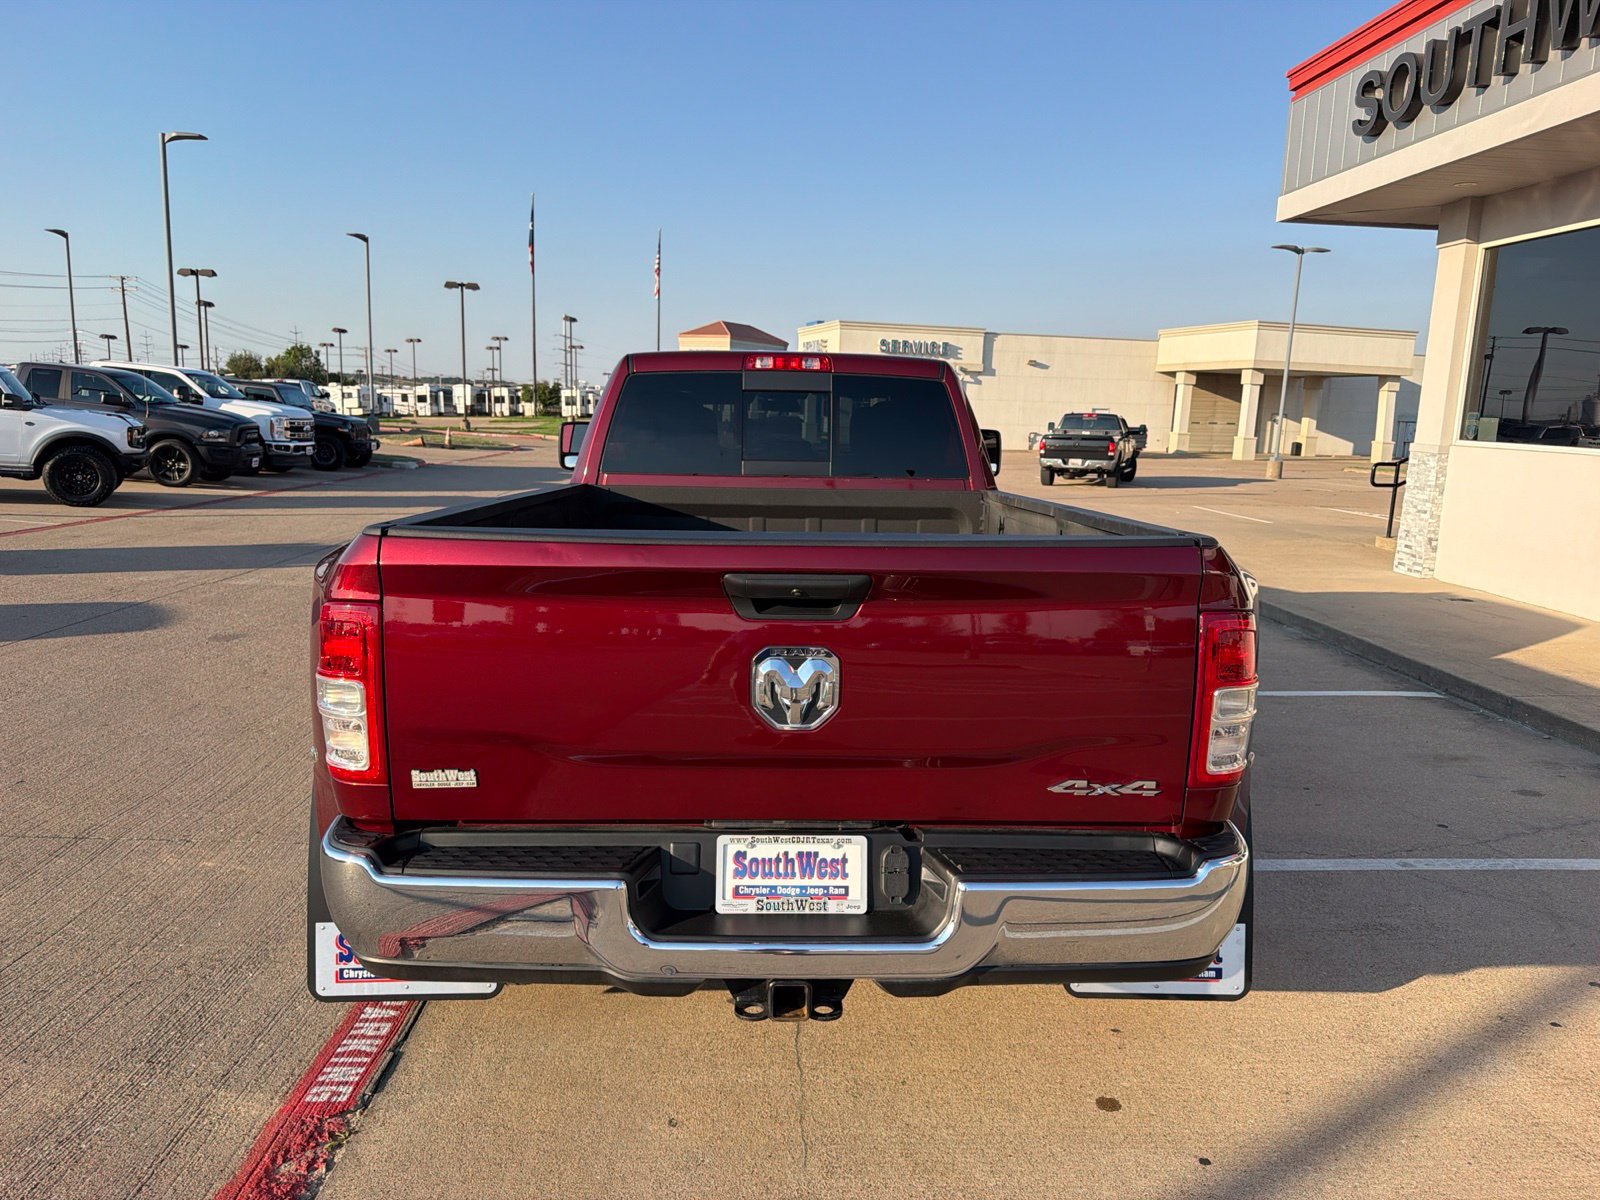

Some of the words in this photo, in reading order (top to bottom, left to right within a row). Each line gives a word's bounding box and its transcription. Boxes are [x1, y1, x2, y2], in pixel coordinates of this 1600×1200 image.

[880, 339, 950, 357] SERVICE
[770, 648, 826, 656] RAM
[411, 769, 476, 781] SouthWest
[1047, 780, 1162, 796] 4x4
[733, 850, 849, 880] SouthWest
[739, 886, 770, 895] Chrysler
[777, 886, 801, 895] Dodge
[806, 886, 824, 895] Jeep
[829, 886, 845, 894] Ram
[756, 899, 828, 911] SouthWest
[1198, 970, 1216, 978] am
